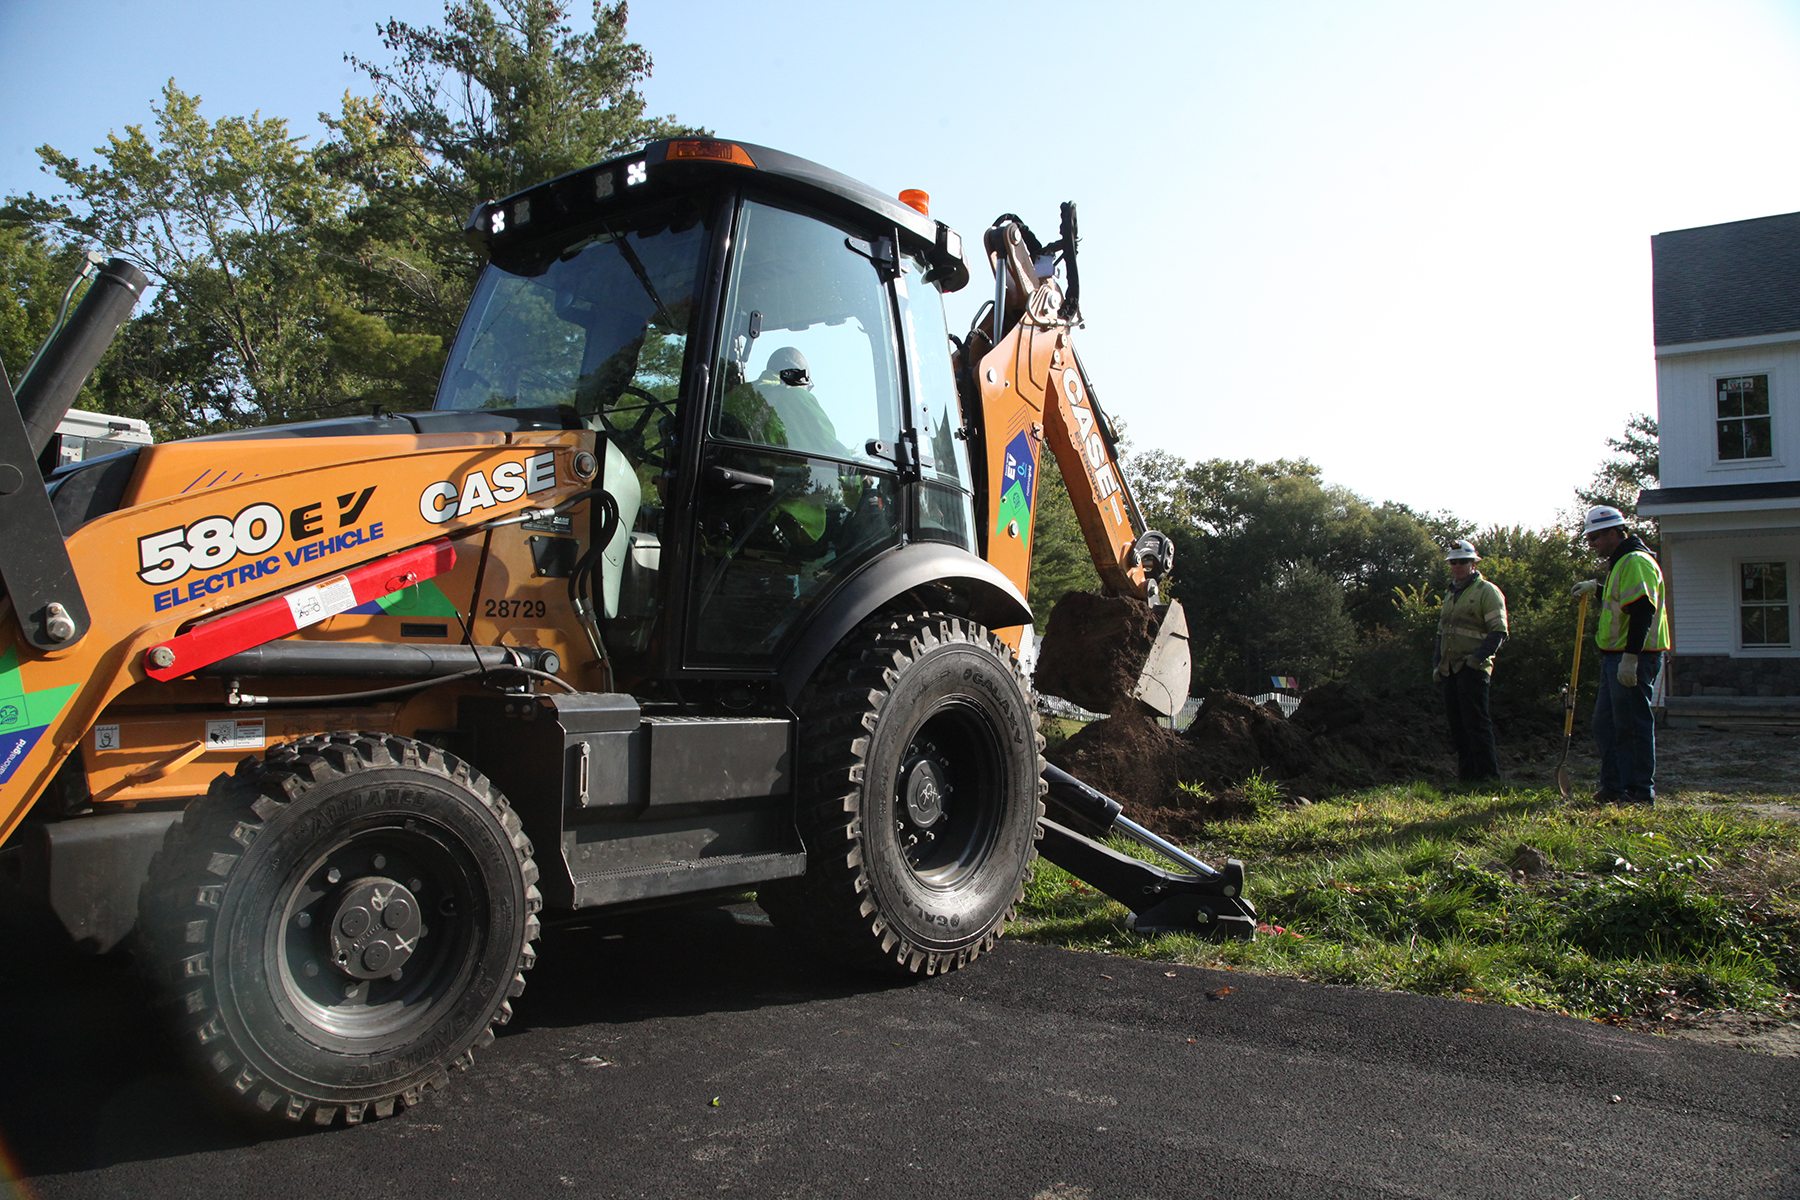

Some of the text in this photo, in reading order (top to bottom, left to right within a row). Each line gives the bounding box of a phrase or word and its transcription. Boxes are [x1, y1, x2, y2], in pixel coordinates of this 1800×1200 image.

[1062, 367, 1118, 500] CASE
[419, 451, 556, 524] CASE
[136, 501, 285, 586] 580
[153, 555, 281, 613] ELECTRIC
[284, 521, 384, 567] VEHICLE
[485, 599, 546, 618] 28729
[972, 671, 1023, 745] GALAXY
